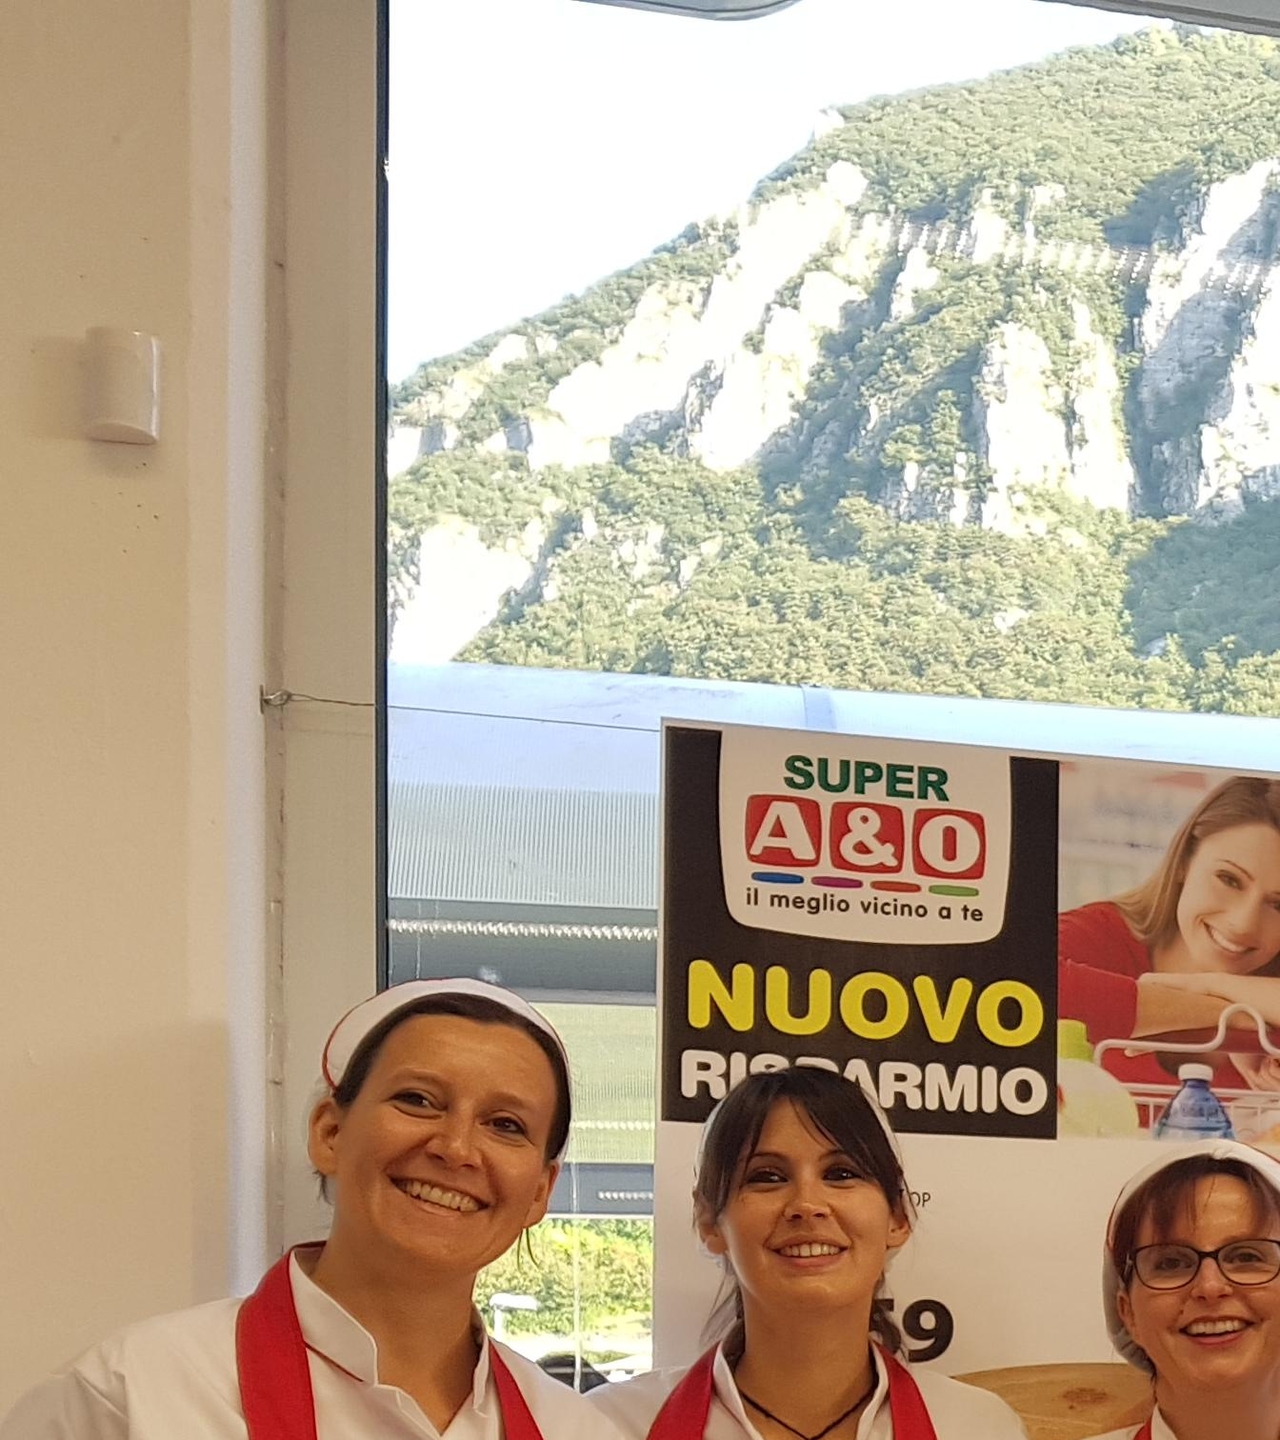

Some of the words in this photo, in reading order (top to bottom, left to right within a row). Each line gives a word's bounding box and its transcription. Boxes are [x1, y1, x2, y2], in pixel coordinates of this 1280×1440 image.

[784, 755, 949, 802] SUPER
[748, 800, 982, 874] A&O
[746, 888, 759, 906] il
[769, 893, 850, 914] meglio
[860, 898, 928, 918] vicino
[938, 906, 952, 920] a
[961, 904, 984, 922] te
[688, 959, 1044, 1047] NUOVO
[681, 1049, 1048, 1116] RIARMIO
